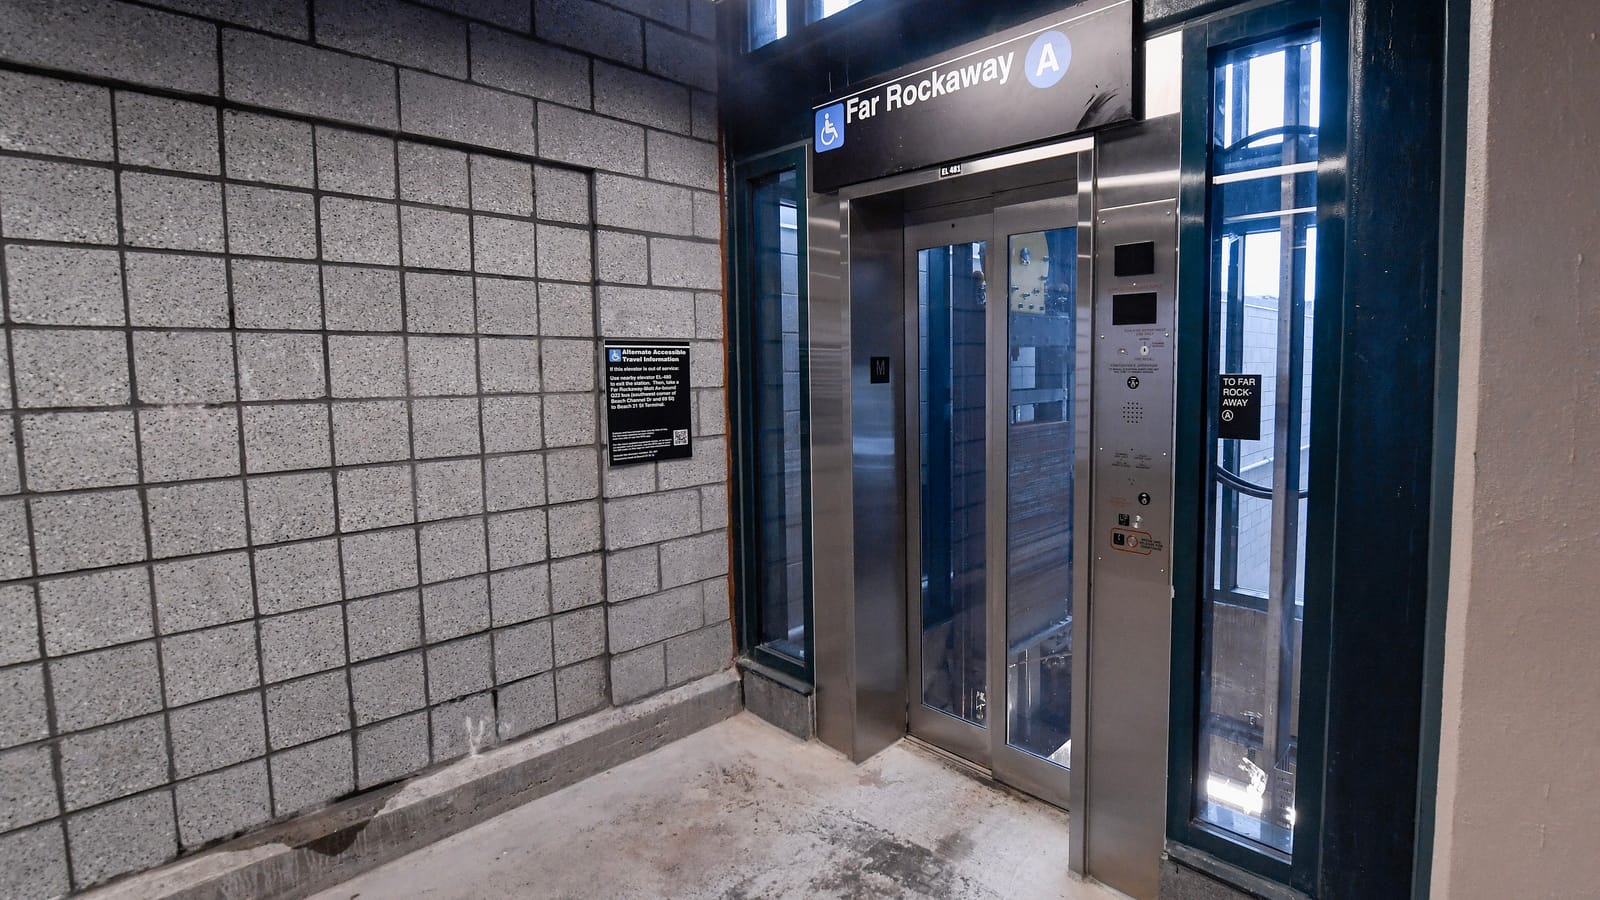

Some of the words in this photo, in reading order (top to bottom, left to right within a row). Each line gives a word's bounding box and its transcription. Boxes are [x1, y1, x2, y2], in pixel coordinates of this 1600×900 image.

[846, 95, 880, 124] Far
[886, 51, 1015, 112] Rockaway
[1035, 42, 1060, 77] A
[941, 167, 949, 176] EL
[876, 359, 885, 376] M
[1222, 377, 1236, 386] TO
[1237, 377, 1256, 386] FAR
[1223, 388, 1252, 396] ROCK-
[1222, 398, 1248, 407] AWAY
